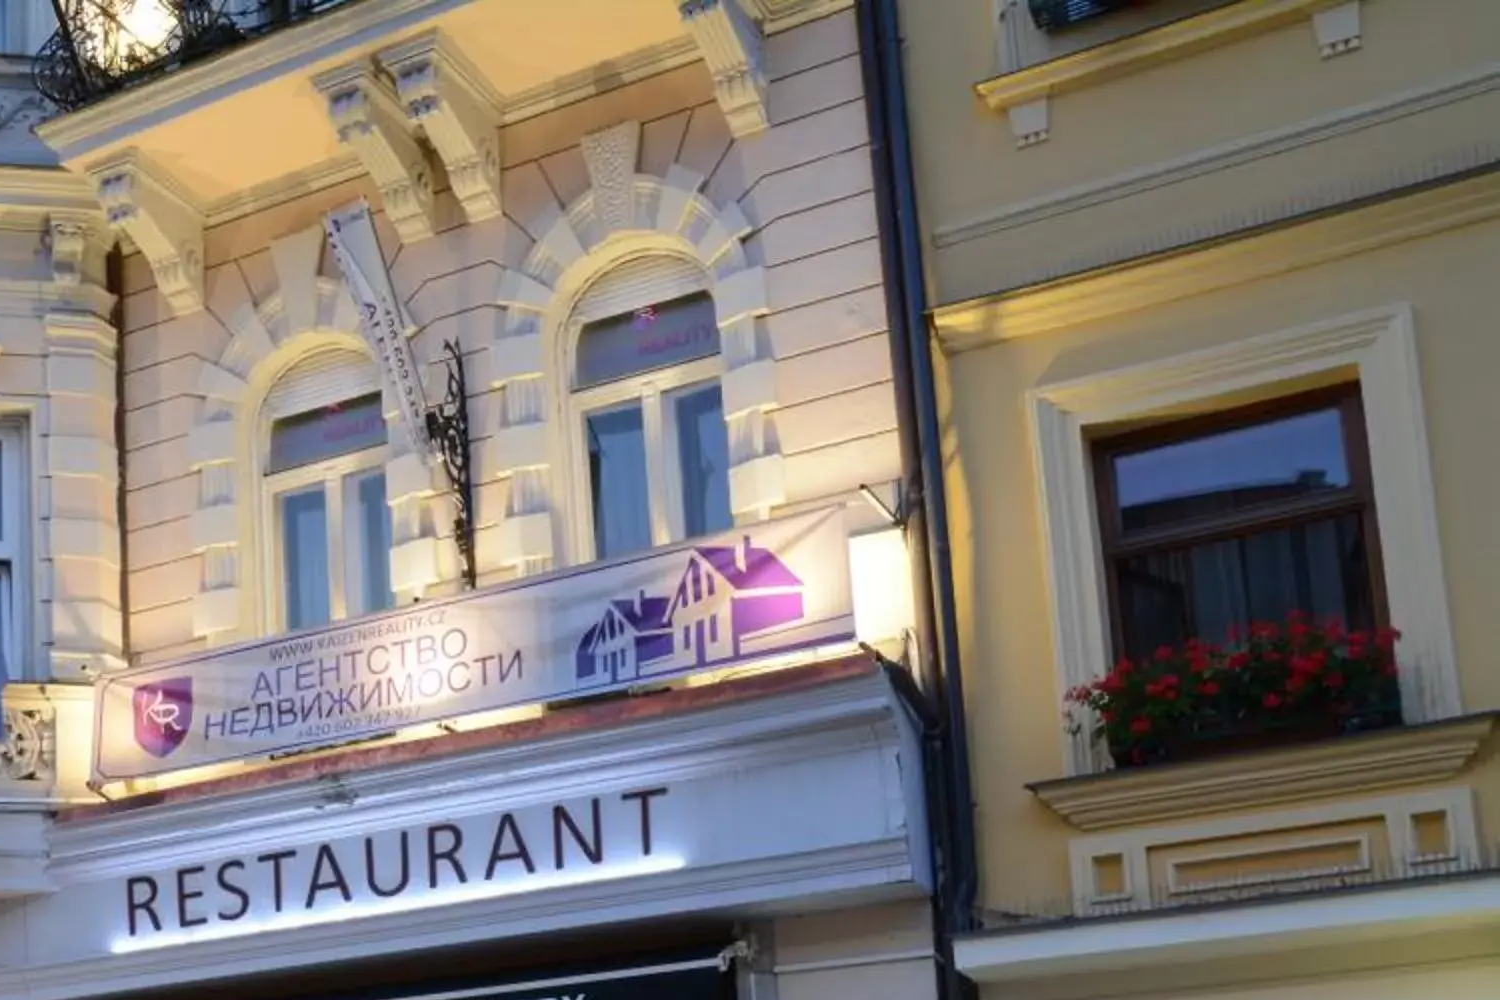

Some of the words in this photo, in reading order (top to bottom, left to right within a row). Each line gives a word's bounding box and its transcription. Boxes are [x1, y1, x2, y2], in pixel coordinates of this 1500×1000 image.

[204, 649, 523, 741] НЕДВИЖИМОСТИ
[252, 628, 467, 700] АГЕНТСТВО
[126, 787, 668, 936] RESTAURANT
